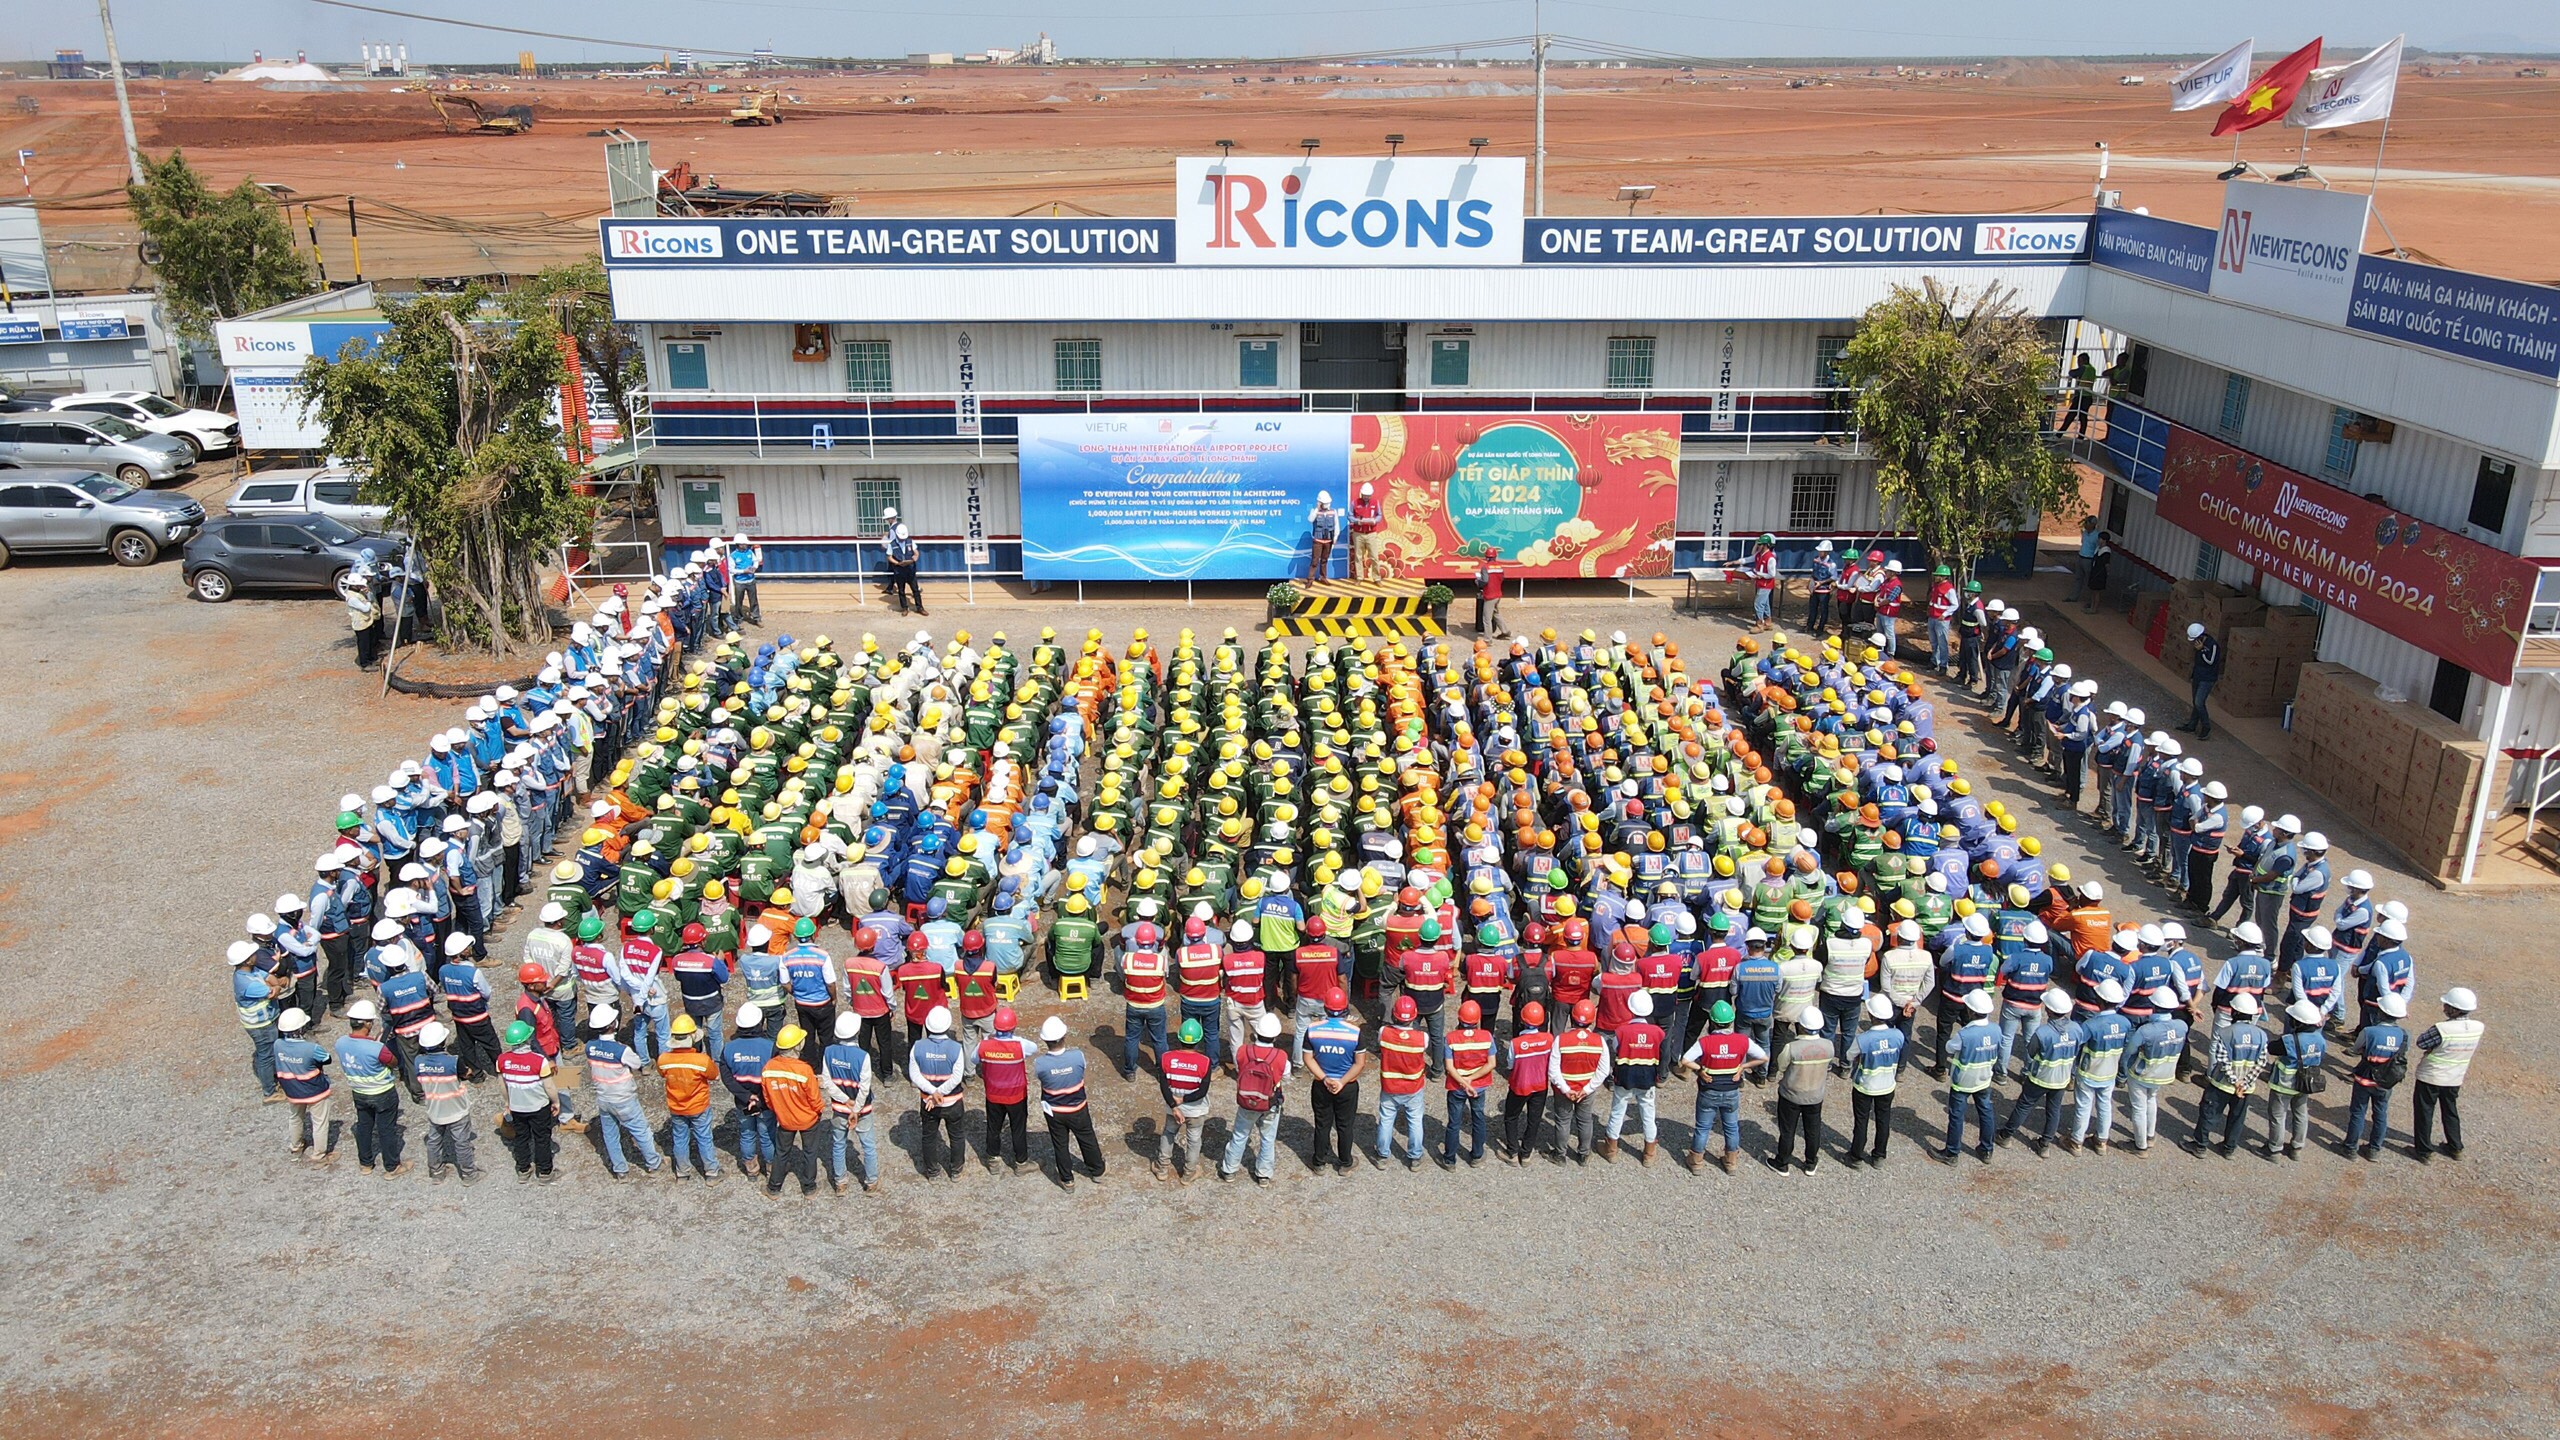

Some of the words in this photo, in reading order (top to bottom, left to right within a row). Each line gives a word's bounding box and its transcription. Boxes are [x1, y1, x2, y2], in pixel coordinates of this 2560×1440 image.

[2178, 66, 2234, 92] VIETUR
[736, 230, 799, 254] ONE
[807, 229, 1001, 254] TEAM-GREAT
[1011, 229, 1158, 254] SOLUTION
[1540, 228, 1602, 253] ONE
[1612, 228, 1805, 253] TEAM-GREAT
[1813, 227, 1962, 252] SOLUTION
[2098, 230, 2114, 250] VĂN
[2116, 234, 2146, 258] PHÒNG
[2147, 244, 2167, 262] BAN
[2168, 244, 2186, 266] CHỈ
[2186, 254, 2208, 273] HUY
[2250, 233, 2348, 272] NEWTECONS
[2363, 272, 2382, 294] DỰ
[2382, 272, 2403, 296] ÁN:
[2404, 278, 2431, 302] NHÀ
[2434, 286, 2453, 306] GA
[2456, 286, 2494, 314] HÀNH
[2497, 296, 2550, 325] KHÁCH
[2353, 298, 2377, 321] SÂN
[2379, 308, 2404, 326] BAY
[2405, 310, 2442, 335] QUỐC
[2444, 316, 2465, 340] TẾ
[2464, 324, 2503, 350] LONG
[2507, 332, 2558, 362] THÀNH
[1086, 422, 1128, 432] VIETUR
[1255, 422, 1282, 431] ACV
[1126, 464, 1242, 489] Congratulation
[1458, 462, 1484, 481] TẾT
[1488, 464, 1531, 481] GIÁP
[1536, 462, 1573, 481] THÌN
[1488, 485, 1540, 503] 2024
[1512, 505, 1542, 515] THẮNG
[2292, 496, 2348, 529] NEWTECONS
[2199, 492, 2239, 526] CHÚC
[2240, 512, 2291, 550] MỪNG
[2292, 536, 2335, 573] NĂM
[2337, 556, 2376, 591] MỚI
[2376, 575, 2435, 617] 2024
[2237, 539, 2279, 572] HAPPY
[2282, 561, 2314, 589] NEW
[2318, 577, 2357, 610] YEAR
[1266, 903, 1289, 913] ATAD
[1319, 1046, 1345, 1054] ATAD
